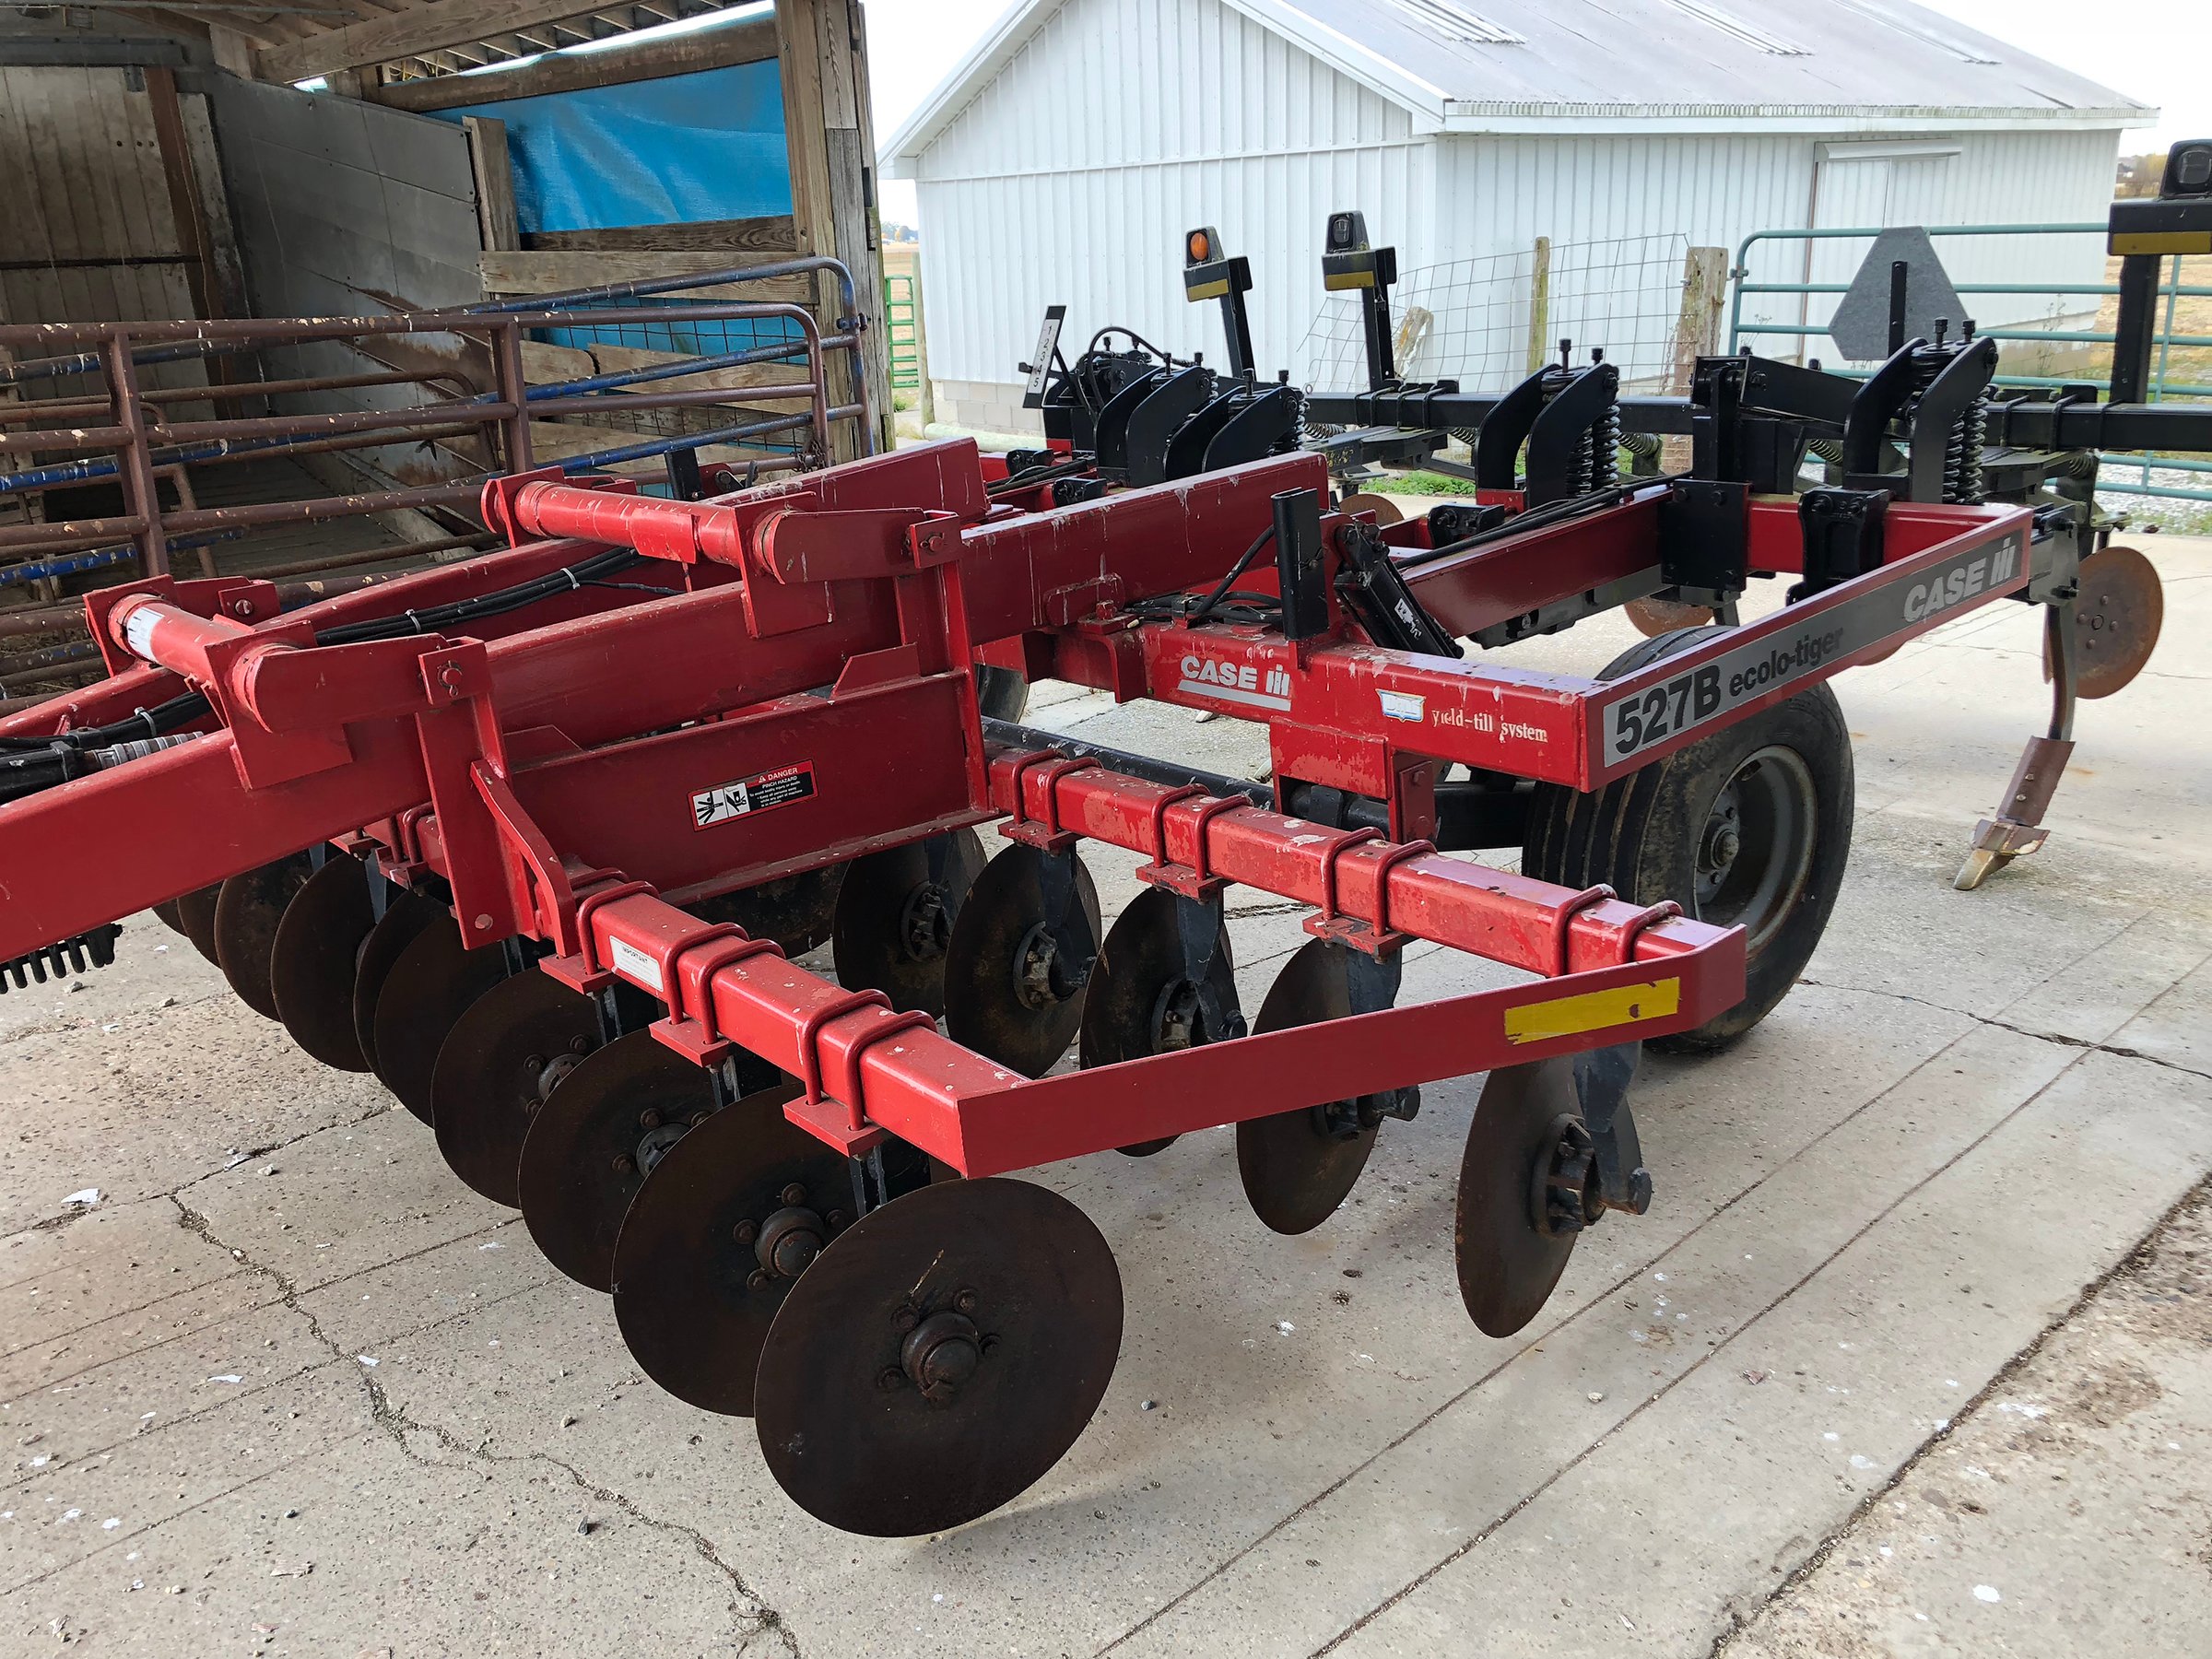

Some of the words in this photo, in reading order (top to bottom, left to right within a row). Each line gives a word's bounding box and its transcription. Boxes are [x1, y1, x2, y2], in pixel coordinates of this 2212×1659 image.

[1048, 325, 1053, 335] 1
[1043, 338, 1050, 348] 2
[1040, 351, 1046, 361] 3
[1037, 364, 1042, 375] 4
[1033, 378, 1039, 387] 5
[1903, 557, 1987, 622] CASE
[1181, 655, 1257, 690] CASE
[1615, 665, 1722, 755] 527B
[1729, 627, 1843, 697] ecolo-tiger
[768, 767, 798, 781] DANGER
[778, 775, 798, 784] HAZARD
